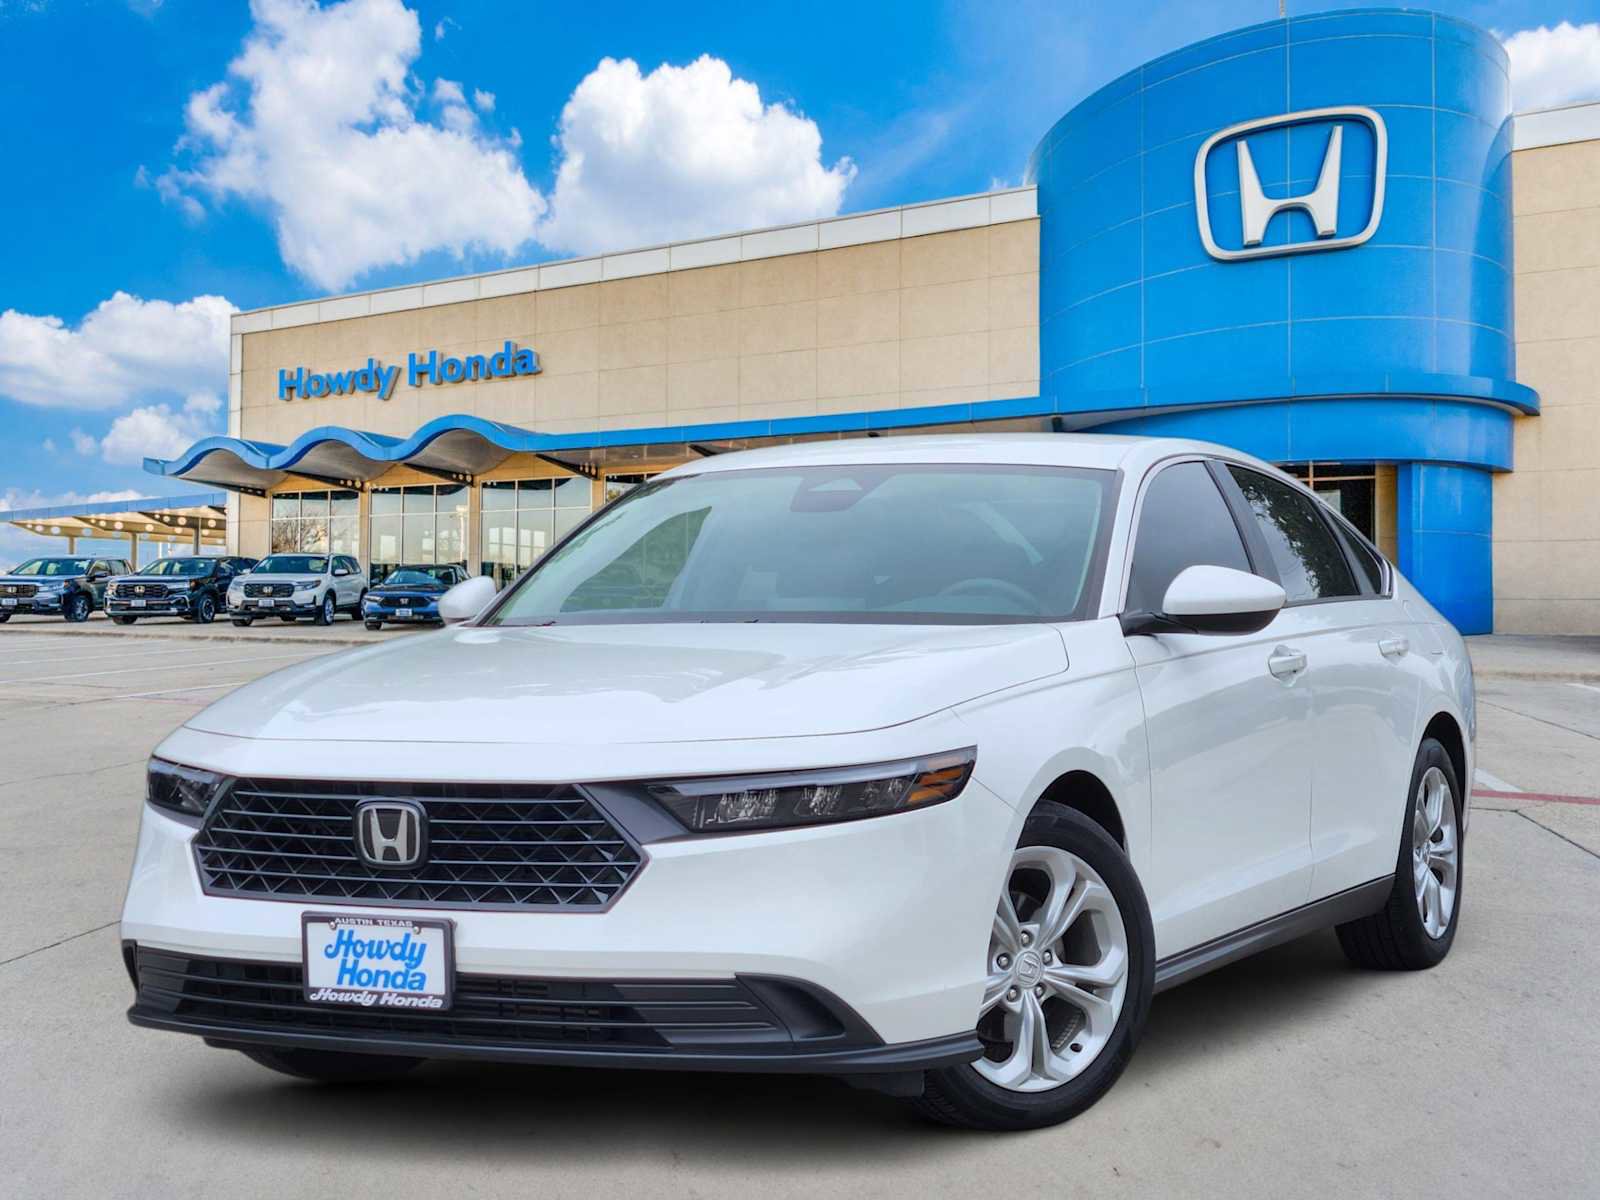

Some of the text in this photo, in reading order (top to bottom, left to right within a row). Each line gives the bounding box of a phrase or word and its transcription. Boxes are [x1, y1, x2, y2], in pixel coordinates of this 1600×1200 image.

[278, 340, 542, 401] Howdy Honda
[334, 917, 414, 928] AUSTIN TEXAS
[324, 928, 427, 970] Howdy
[336, 958, 427, 991] Honda
[309, 988, 443, 1008] Howdy Honda
